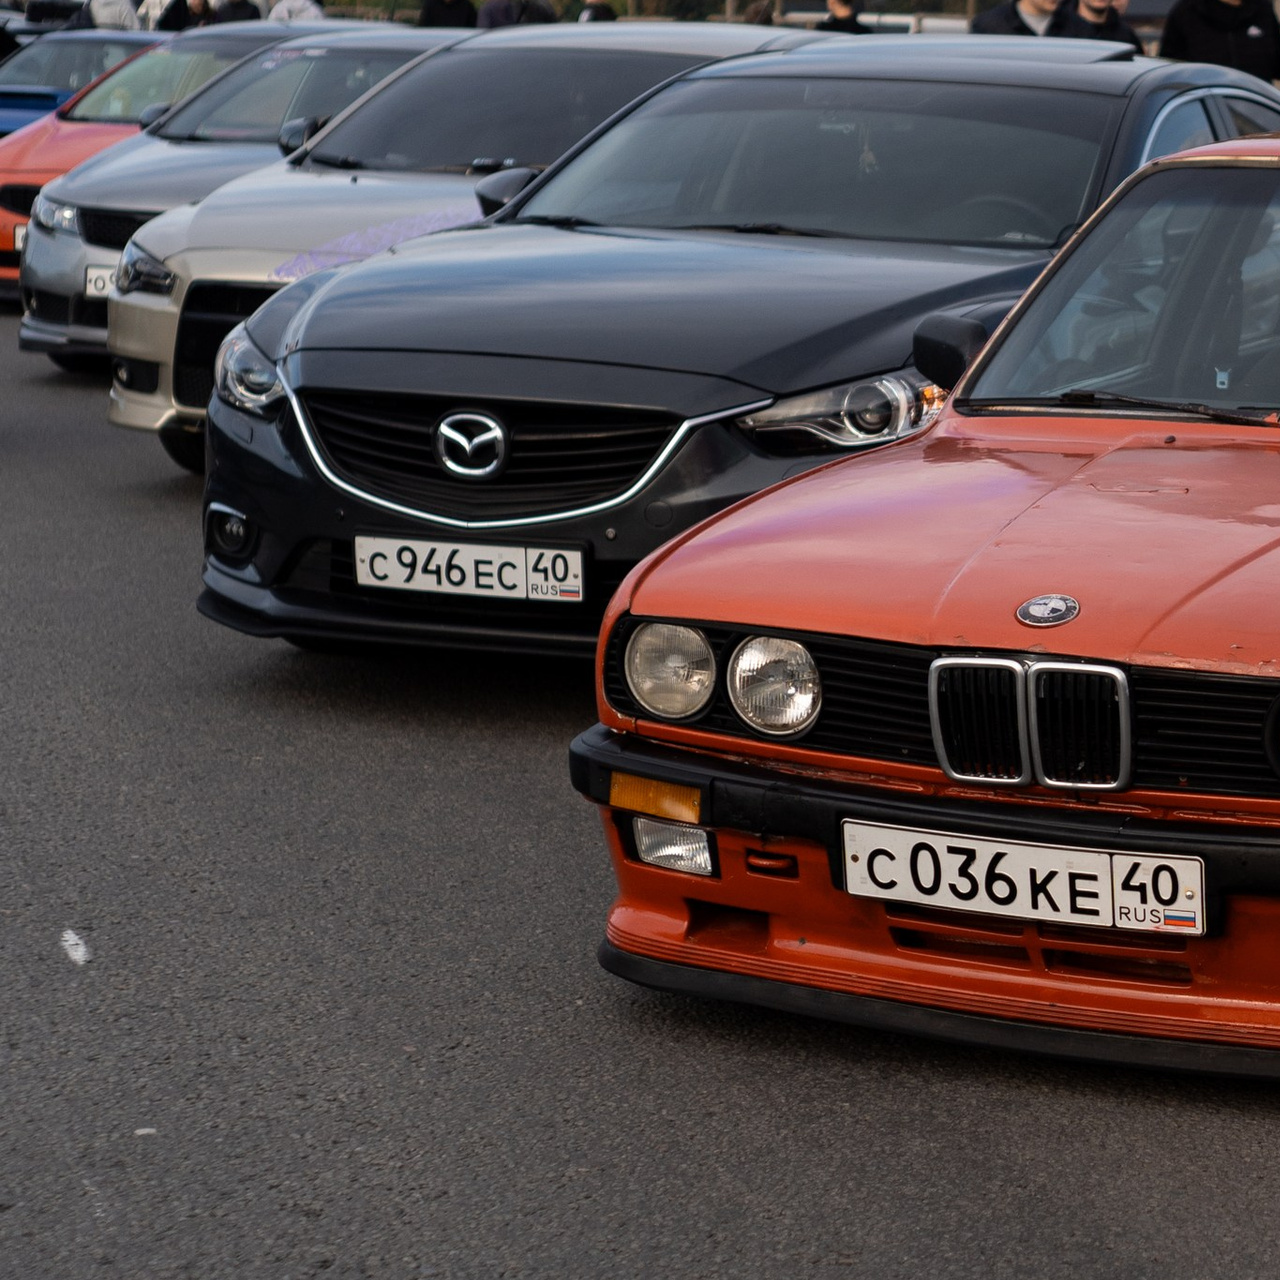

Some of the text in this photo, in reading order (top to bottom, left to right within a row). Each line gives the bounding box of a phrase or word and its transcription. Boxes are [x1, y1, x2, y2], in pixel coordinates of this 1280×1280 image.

[531, 552, 569, 583] 40
[531, 584, 558, 596] RUS
[1121, 862, 1179, 906] 40
[1118, 906, 1162, 924] RUS
